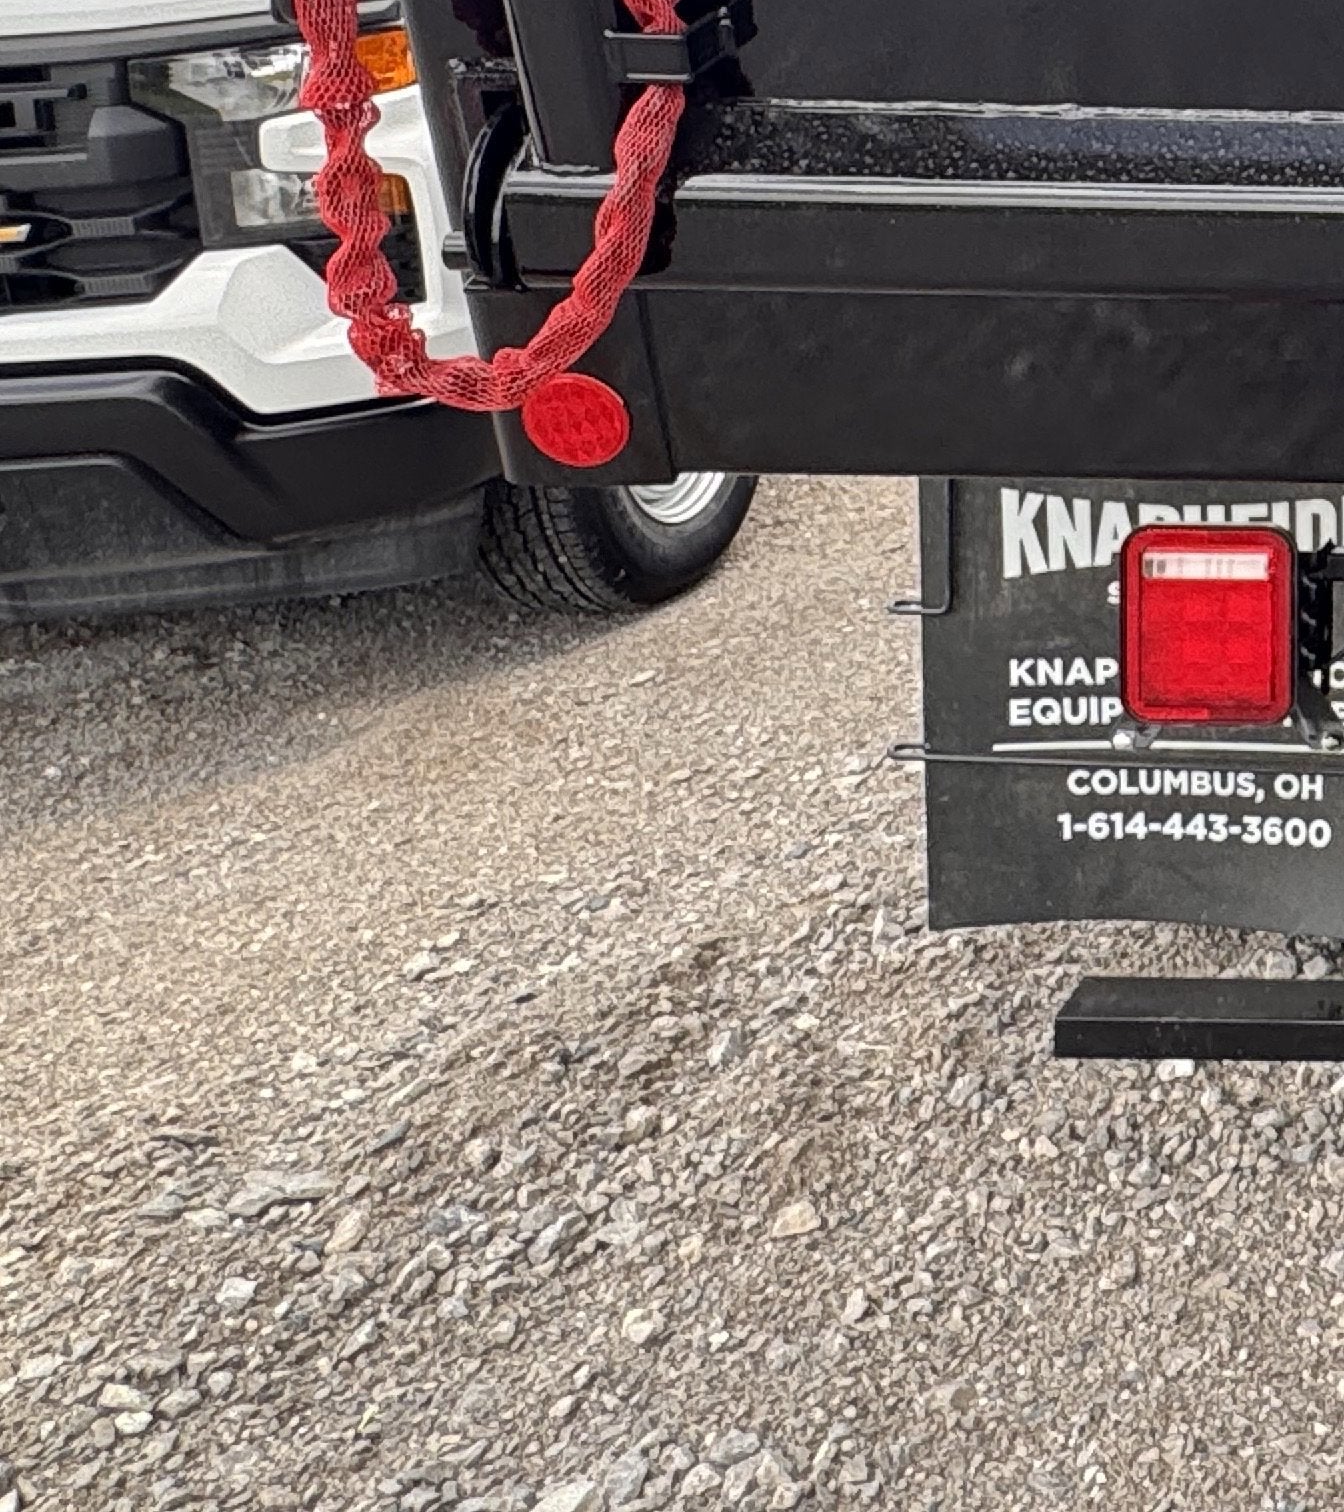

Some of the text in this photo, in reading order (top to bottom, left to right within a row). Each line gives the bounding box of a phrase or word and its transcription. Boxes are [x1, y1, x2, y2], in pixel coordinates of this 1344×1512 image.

[1009, 696, 1123, 727] EQUIP
[1066, 768, 1324, 803] COLUMBUS, OH
[1056, 811, 1332, 848] 1-614-443-3600
